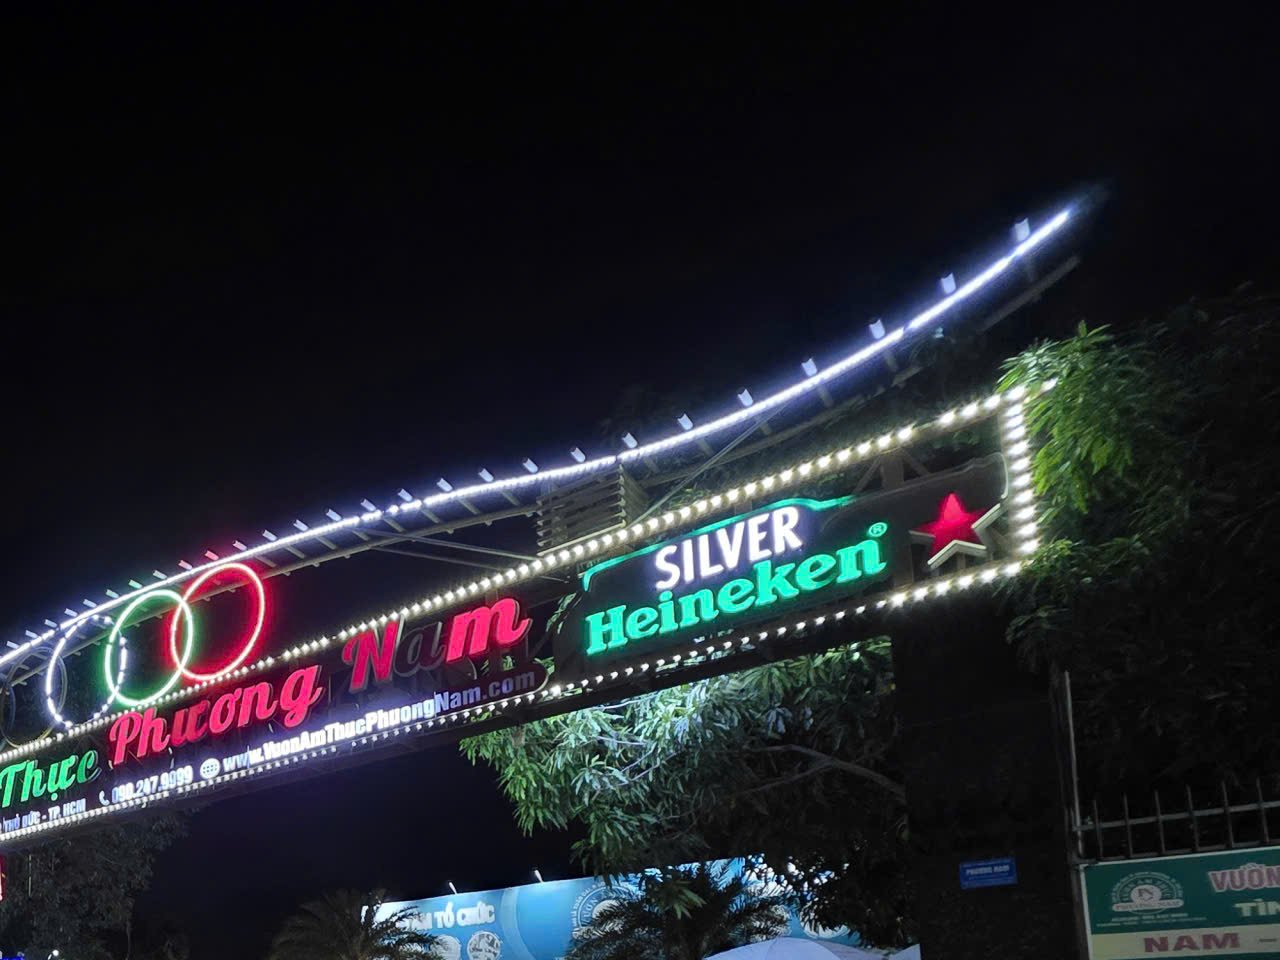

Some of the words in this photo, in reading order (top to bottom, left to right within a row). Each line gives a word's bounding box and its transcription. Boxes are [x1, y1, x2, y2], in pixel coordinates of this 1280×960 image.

[655, 506, 803, 591] SILVER
[585, 537, 888, 656] Heineken
[109, 664, 324, 765] Phương
[342, 596, 530, 692] Nam
[222, 669, 535, 772] www.VuonAmThucPhuongNam.com
[63, 798, 86, 816] HCM
[1144, 933, 1240, 953] NAM
